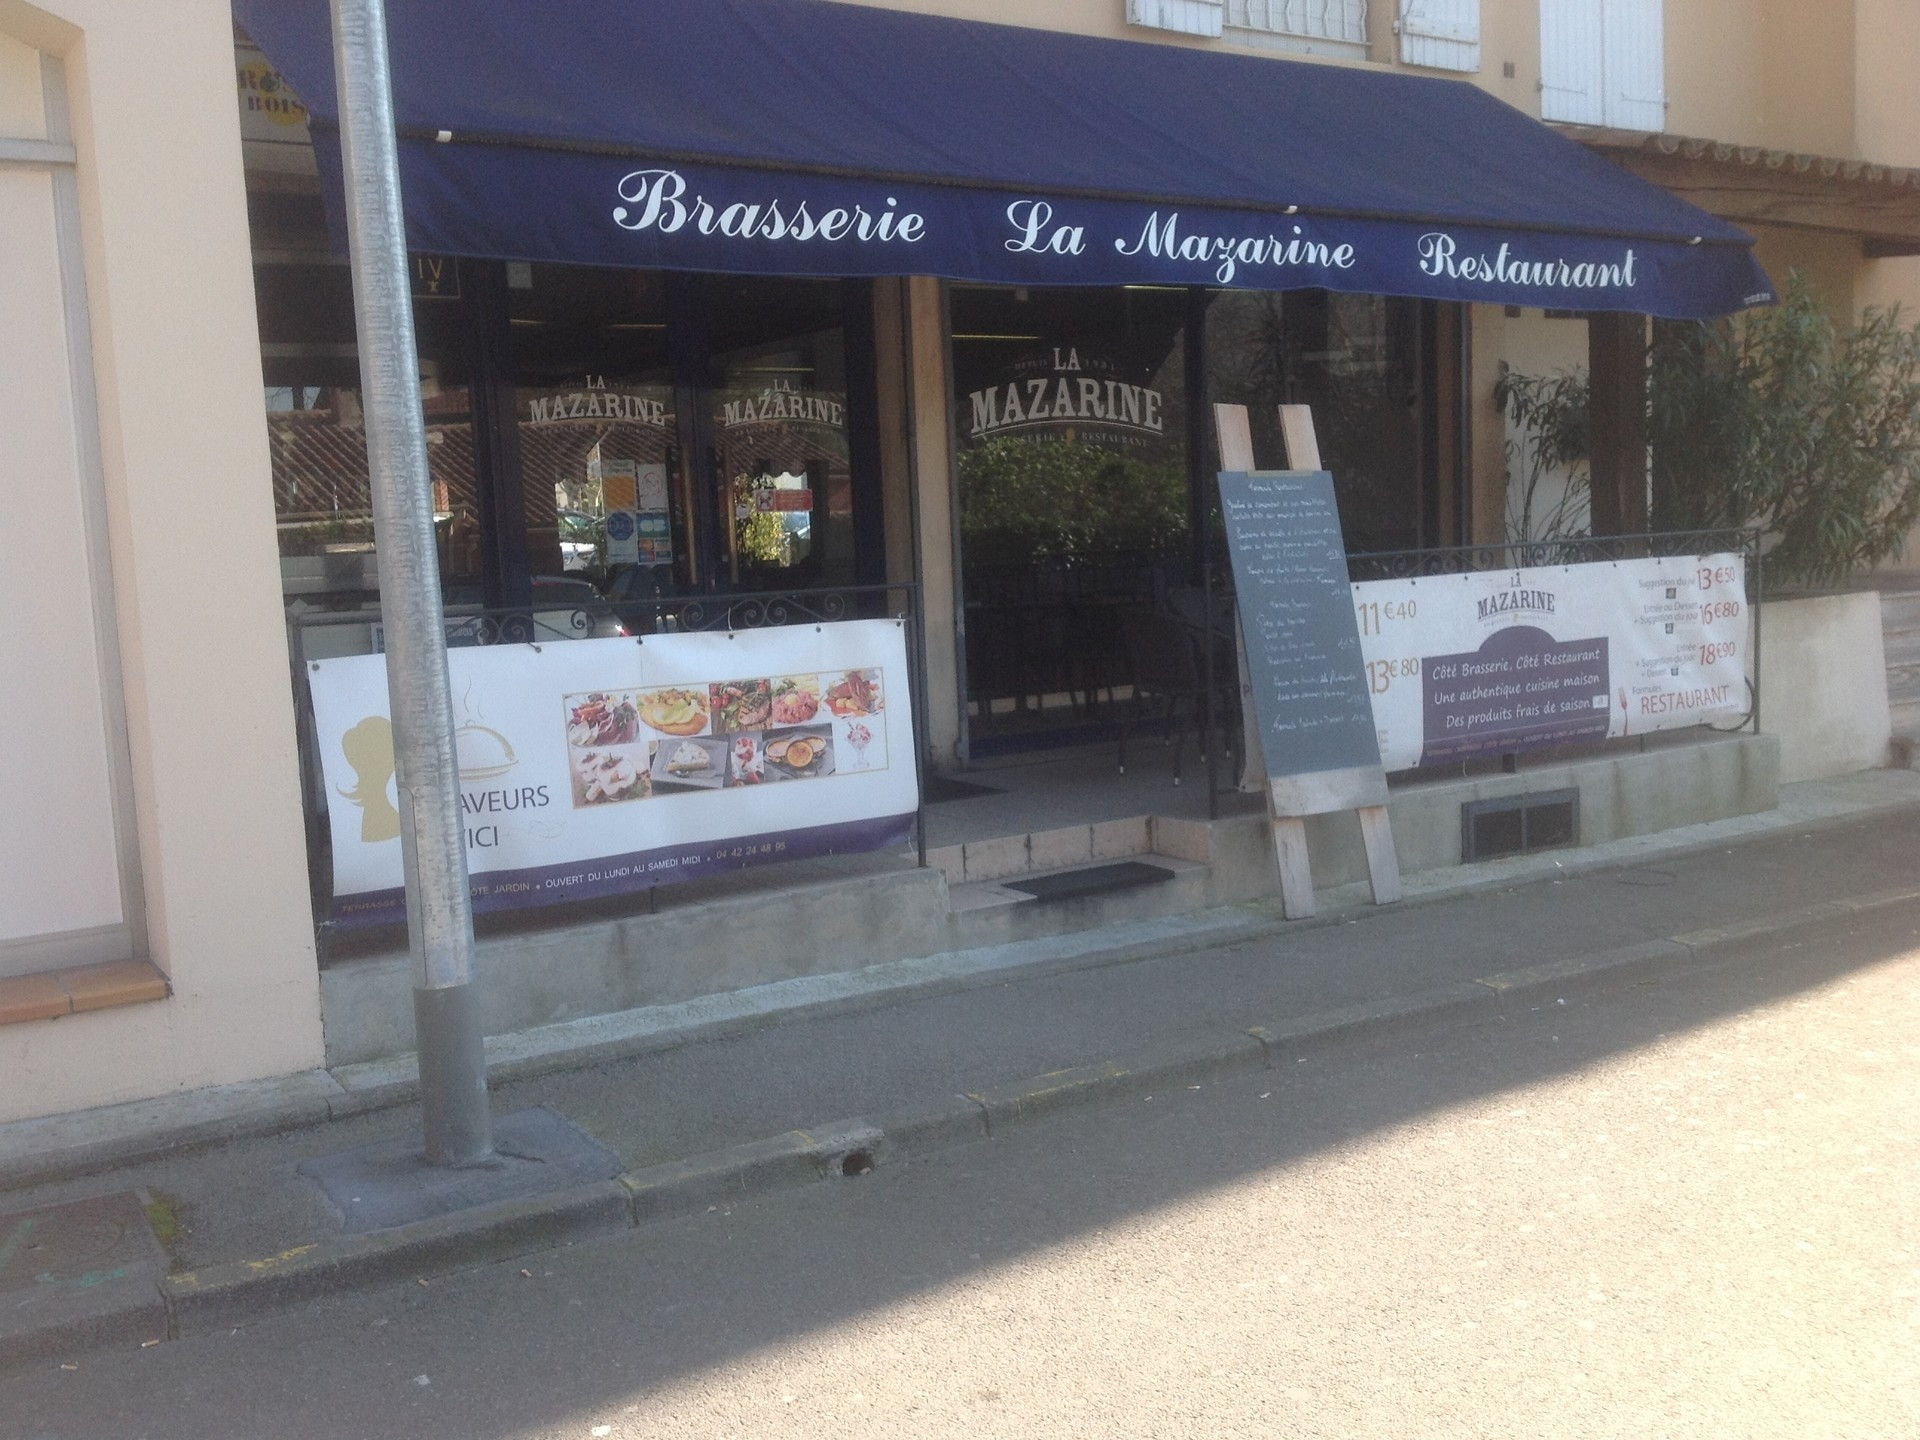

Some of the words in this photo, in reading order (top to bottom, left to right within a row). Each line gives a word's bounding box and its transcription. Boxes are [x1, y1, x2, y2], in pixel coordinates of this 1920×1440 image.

[612, 169, 926, 242] Brasserie
[1004, 200, 1086, 256] La
[1114, 211, 1355, 283] Mazarine
[1417, 232, 1638, 288] Restaurant
[1053, 347, 1081, 370] LA
[585, 374, 606, 390] LA
[774, 379, 791, 393] LA
[528, 392, 666, 427] MAZARINE
[723, 395, 842, 427] MAZARINE
[969, 377, 1163, 434] MAZARINE
[1510, 573, 1522, 588] LA
[1477, 590, 1555, 620] MAZARINE
[1432, 665, 1458, 681] Côté
[1516, 655, 1540, 671] Côté
[1544, 649, 1600, 666] Restaurant
[1434, 691, 1455, 705] Une
[1459, 681, 1522, 702] authentique
[1525, 676, 1560, 693] cuisine
[1563, 671, 1600, 688] maison
[1641, 685, 1730, 715] RESTAURANT
[1446, 714, 1465, 729] Des
[1467, 706, 1513, 729] produits
[1515, 701, 1541, 718] frais
[1543, 699, 1556, 713] de
[1560, 696, 1591, 712] saison
[494, 882, 530, 894] JARDIN
[545, 874, 584, 889] OUVERT
[588, 871, 601, 883] DU
[604, 867, 630, 879] LUNDI
[633, 863, 645, 874] AU
[648, 858, 679, 872] SAMEDI
[682, 854, 701, 865] MIDI
[716, 849, 728, 860] 04
[731, 847, 743, 858] 42
